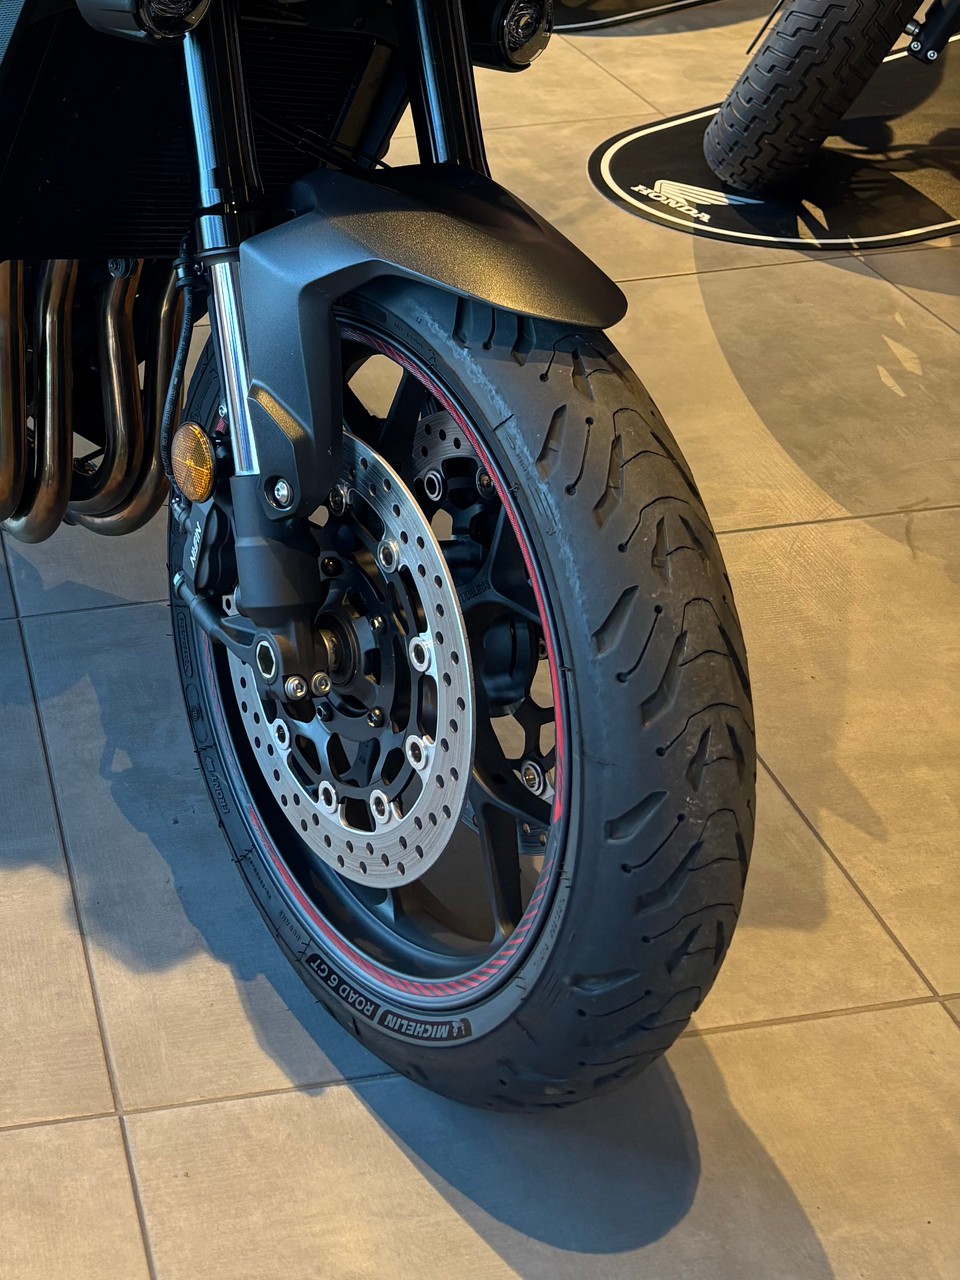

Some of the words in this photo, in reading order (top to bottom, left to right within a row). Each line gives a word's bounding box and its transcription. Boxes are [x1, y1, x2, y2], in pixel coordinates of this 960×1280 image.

[630, 184, 711, 223] HONDA
[310, 957, 329, 979] GT
[327, 975, 339, 988] 6
[339, 983, 376, 1015] ROAD
[384, 1013, 450, 1038] MICHELIN
